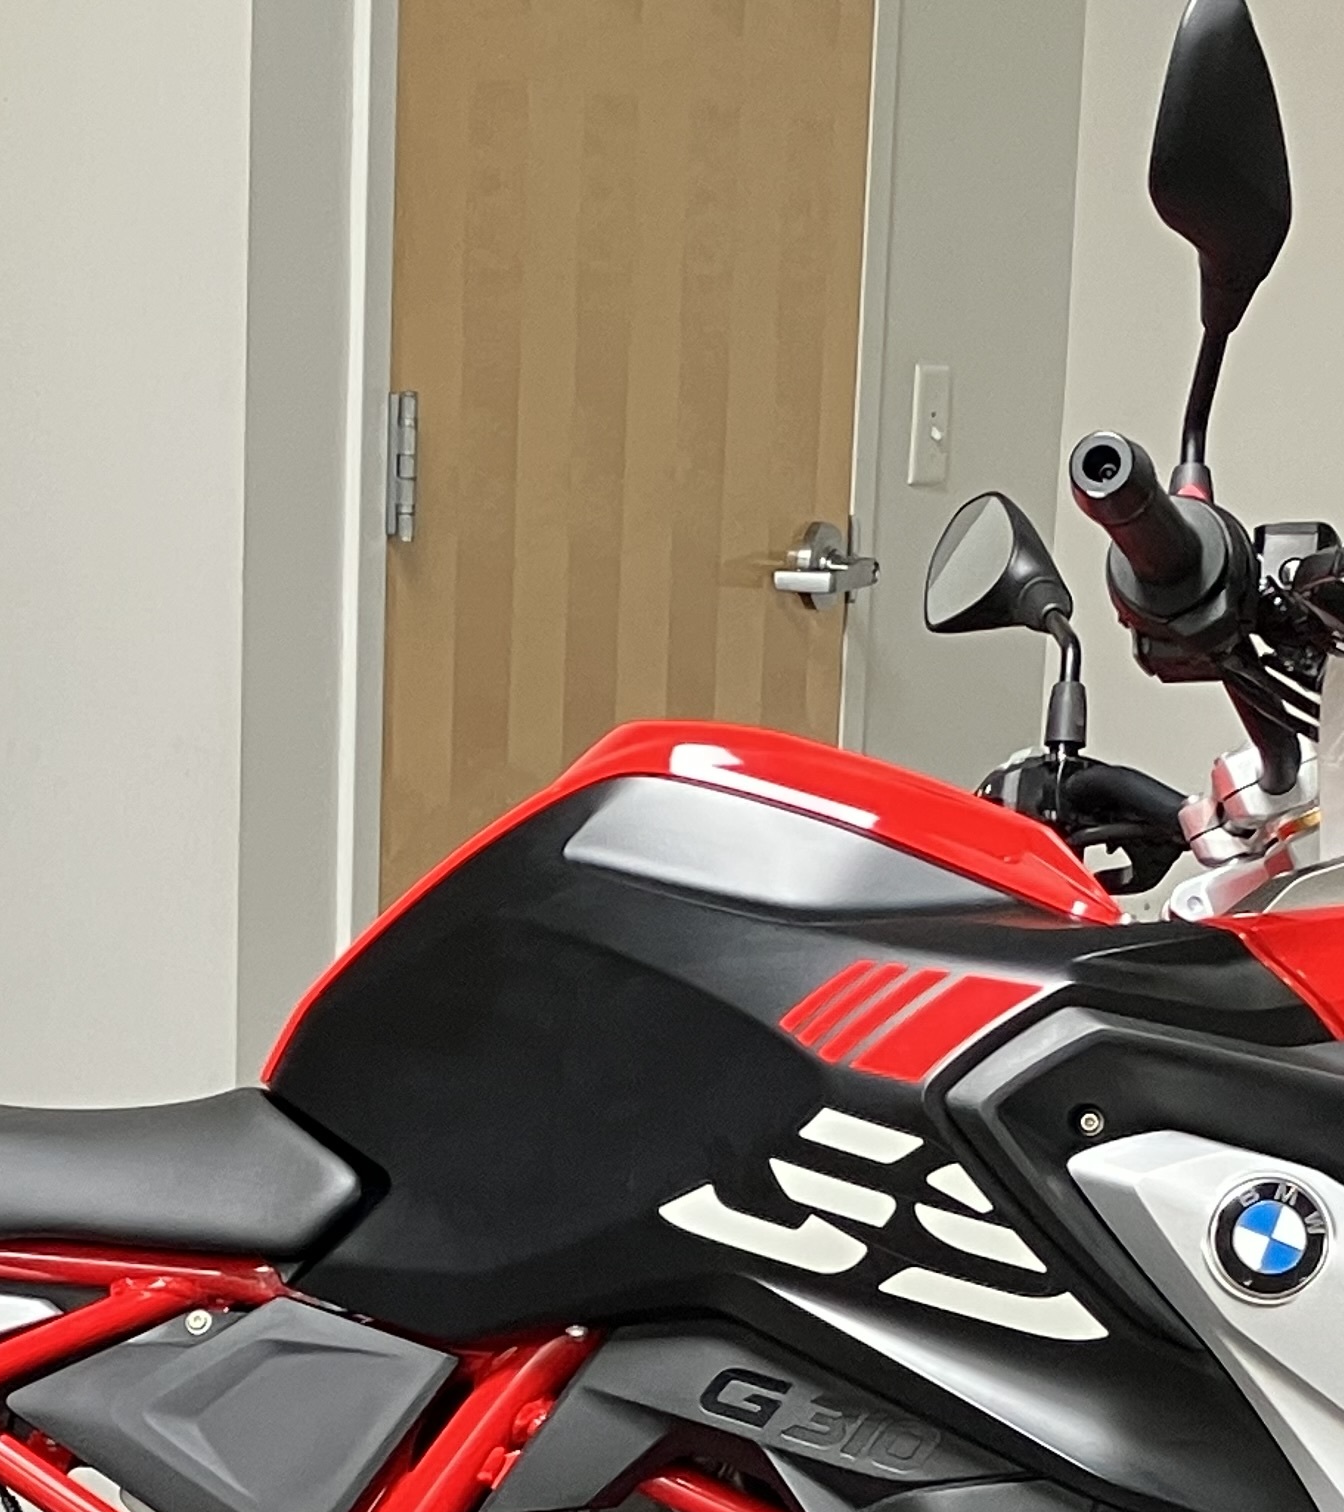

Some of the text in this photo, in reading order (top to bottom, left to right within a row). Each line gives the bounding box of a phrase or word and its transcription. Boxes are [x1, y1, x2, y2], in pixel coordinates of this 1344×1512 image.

[1238, 1181, 1327, 1235] BMW
[699, 1366, 943, 1474] G 310
